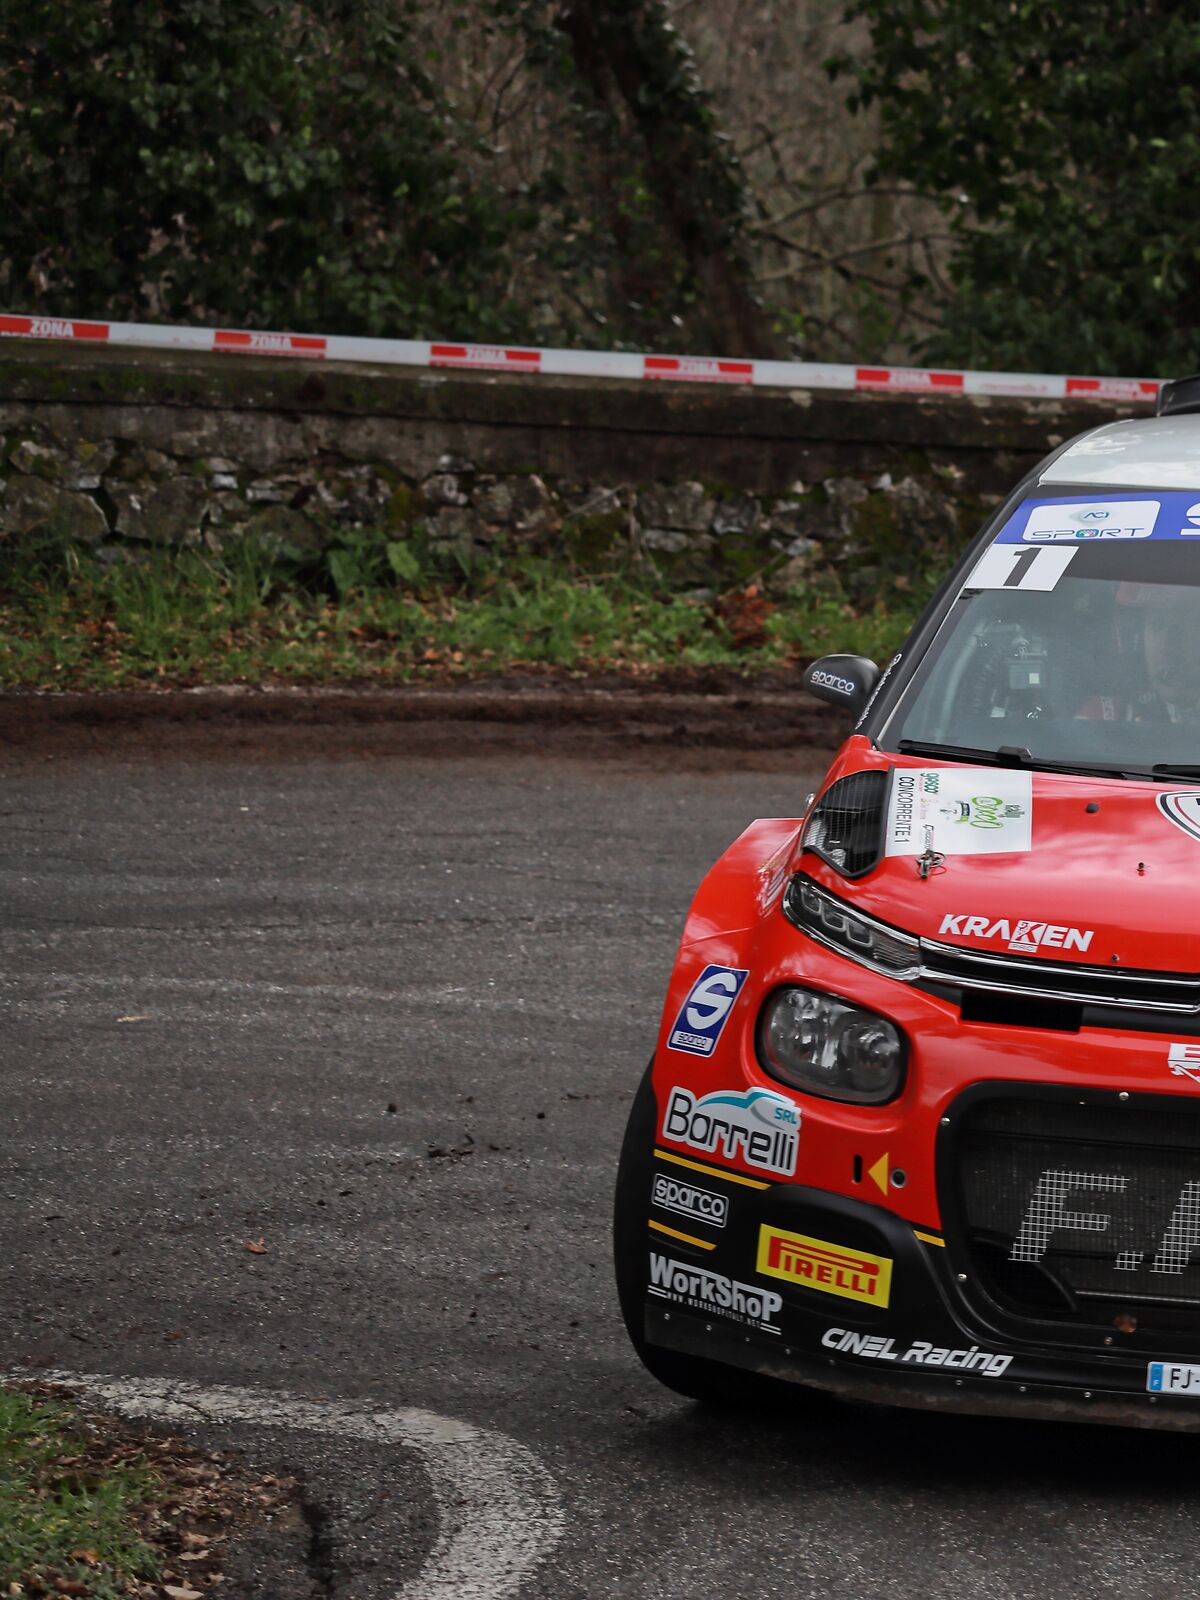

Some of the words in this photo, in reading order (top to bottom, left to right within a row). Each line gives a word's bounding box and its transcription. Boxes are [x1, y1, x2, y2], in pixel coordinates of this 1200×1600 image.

[30, 319, 74, 338] ZONA
[1031, 527, 1145, 540] SPORT
[1083, 511, 1110, 520] ACI
[1003, 547, 1042, 587] 1
[811, 670, 855, 693] sparco
[895, 776, 915, 837] CONCORRENTE
[938, 914, 1094, 952] KRAKEN
[686, 972, 738, 1030] S
[678, 1032, 708, 1047] sparco
[666, 1092, 796, 1170] Borrelli
[774, 1107, 797, 1125] SRL
[655, 1178, 725, 1219] sparco
[767, 1235, 881, 1297] PIRELLI
[821, 1327, 899, 1361] CINEL
[902, 1340, 1014, 1377] Racing
